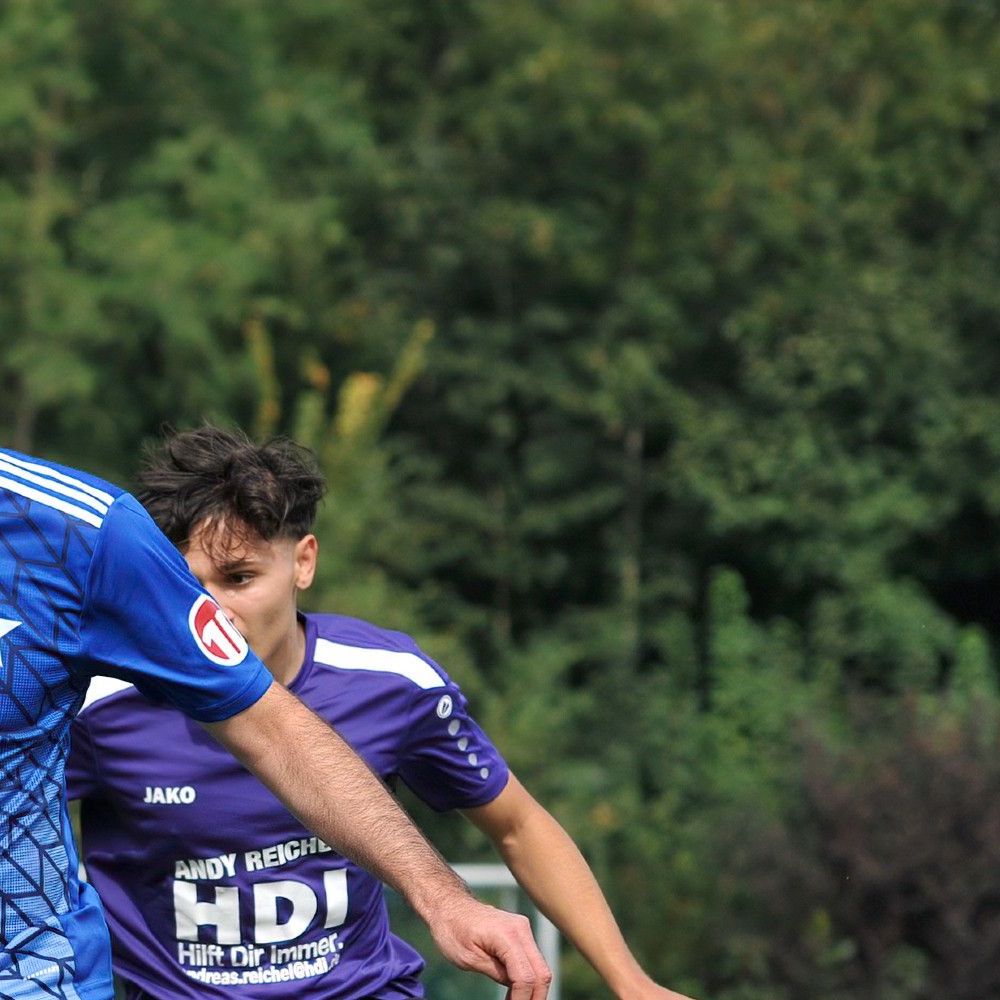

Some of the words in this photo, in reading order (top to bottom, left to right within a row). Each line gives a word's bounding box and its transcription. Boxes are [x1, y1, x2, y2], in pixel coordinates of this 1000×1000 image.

[143, 786, 196, 804] JAKO
[174, 853, 237, 880] ANDY
[244, 837, 332, 872] REICHE
[173, 867, 348, 945] HDI
[178, 942, 225, 967] Hilft
[230, 944, 265, 967] Dir
